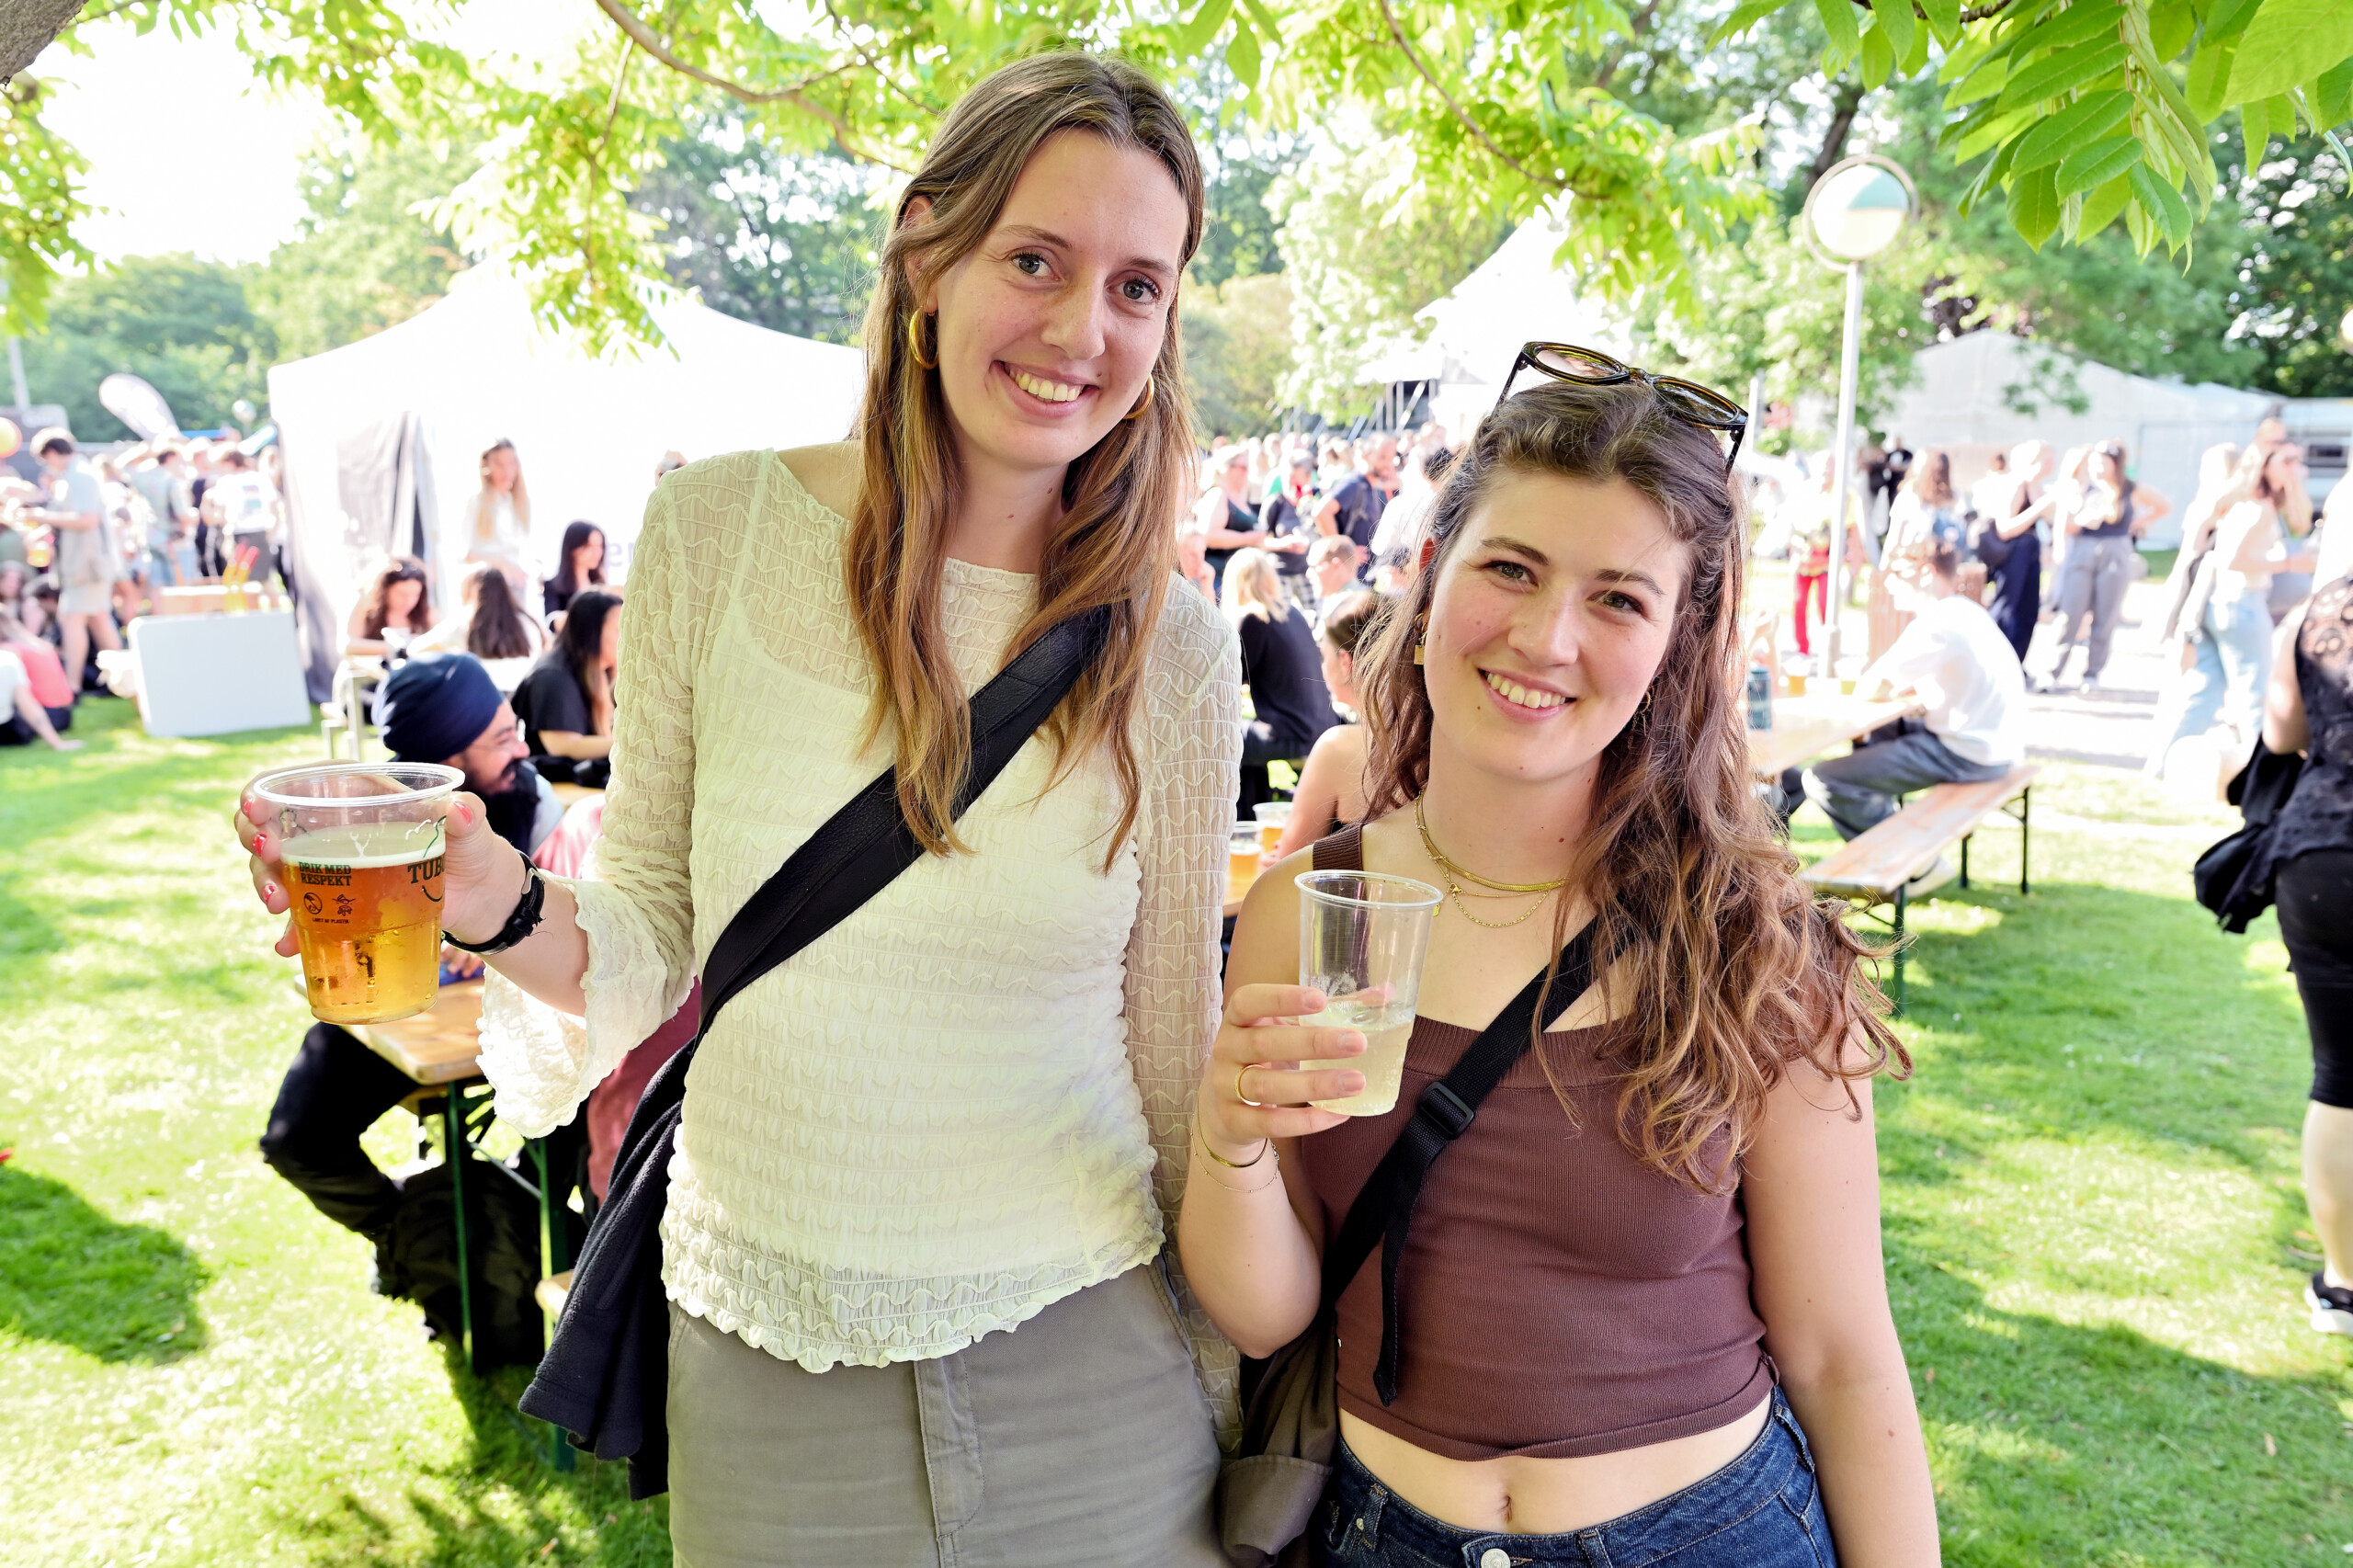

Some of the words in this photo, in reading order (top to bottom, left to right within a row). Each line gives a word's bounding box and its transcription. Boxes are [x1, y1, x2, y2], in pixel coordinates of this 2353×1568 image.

[299, 861, 324, 874] DRIK
[324, 864, 352, 875] MED
[301, 872, 352, 886] RESPEKT
